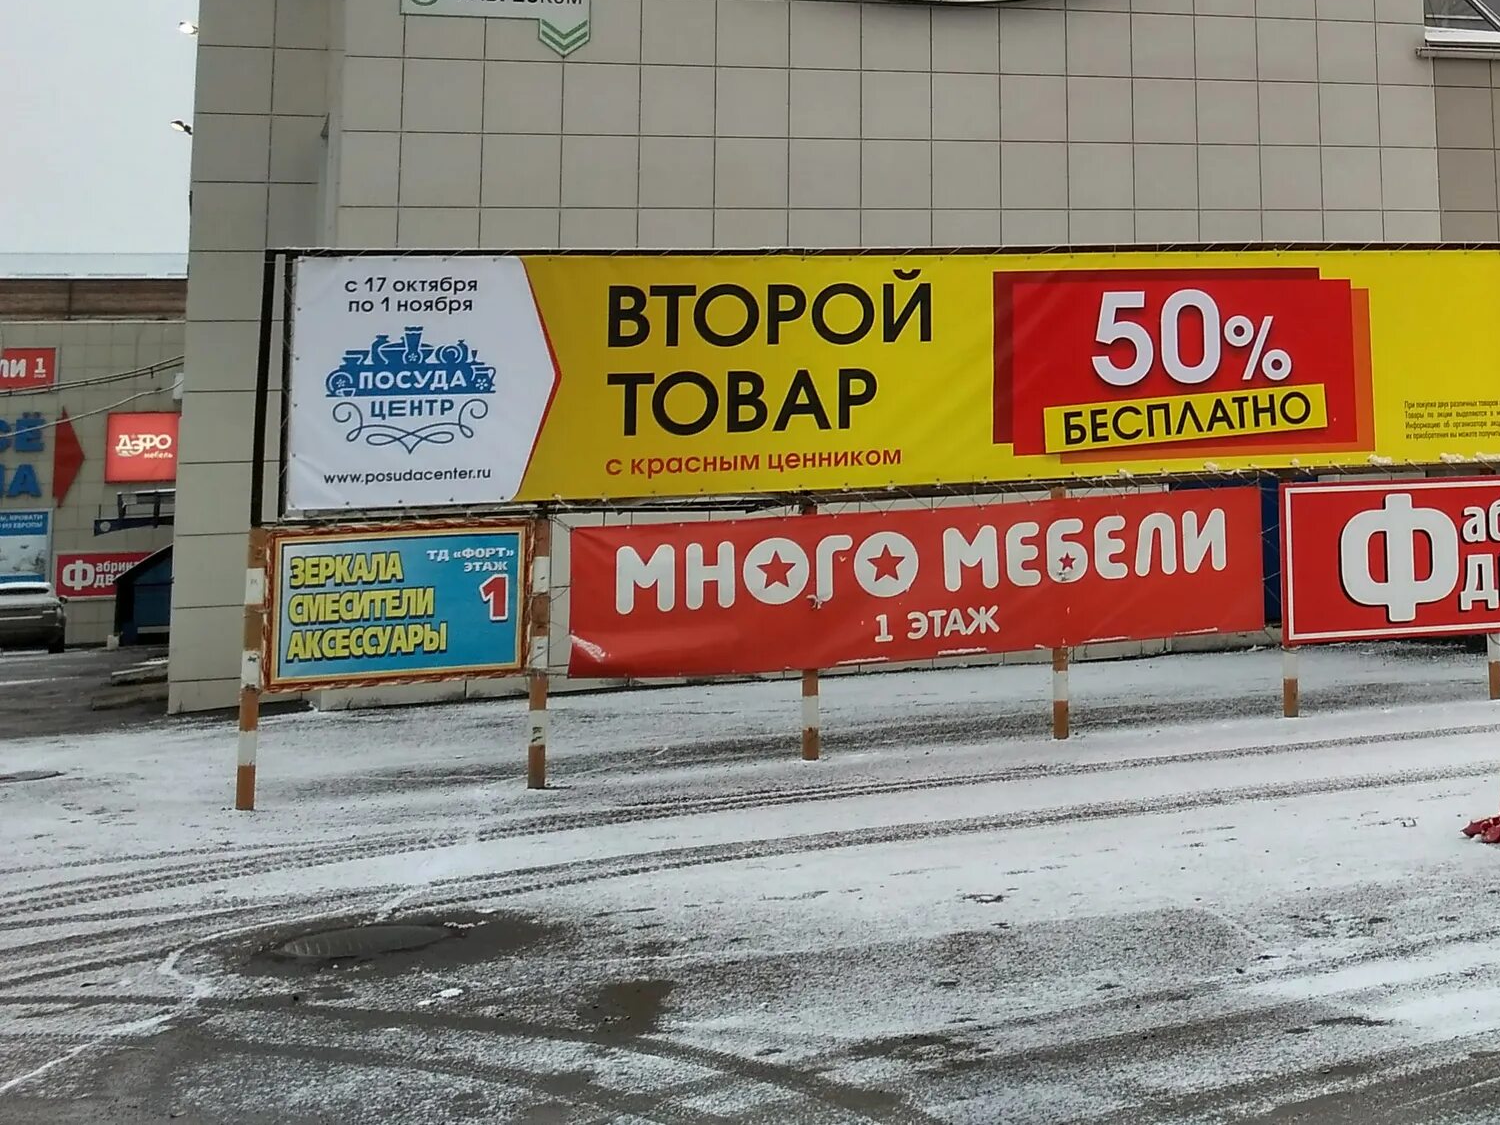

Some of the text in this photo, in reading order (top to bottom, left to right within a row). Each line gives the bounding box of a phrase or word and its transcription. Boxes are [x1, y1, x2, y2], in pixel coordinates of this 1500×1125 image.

[344, 276, 478, 295] с 17 октября
[348, 296, 473, 315] по 1 ноября
[607, 268, 933, 349] ВТОРОЙ
[1091, 288, 1292, 387] 50%
[359, 370, 467, 391] ПОСУДА
[371, 399, 455, 420] ЦЕНТР
[607, 367, 877, 436] ТОВАР
[1063, 391, 1312, 446] БЕСПЛАТНО
[323, 467, 492, 485] www.posudacenter.ru
[605, 447, 902, 480] с красным ценником
[289, 550, 404, 588] ЗЕРКАЛА
[426, 547, 515, 561] ТД «ФОРТ»
[464, 560, 508, 573] ЭТАЖ
[943, 508, 1227, 594] МЕБЕЛИ
[615, 530, 919, 615] МНОГО
[288, 587, 435, 625] СМЕСИТЕЛИ
[479, 573, 510, 621] 1
[286, 621, 448, 663] АКСЕССУАРЫ
[874, 605, 1000, 643] 1 ЭТАЖ
